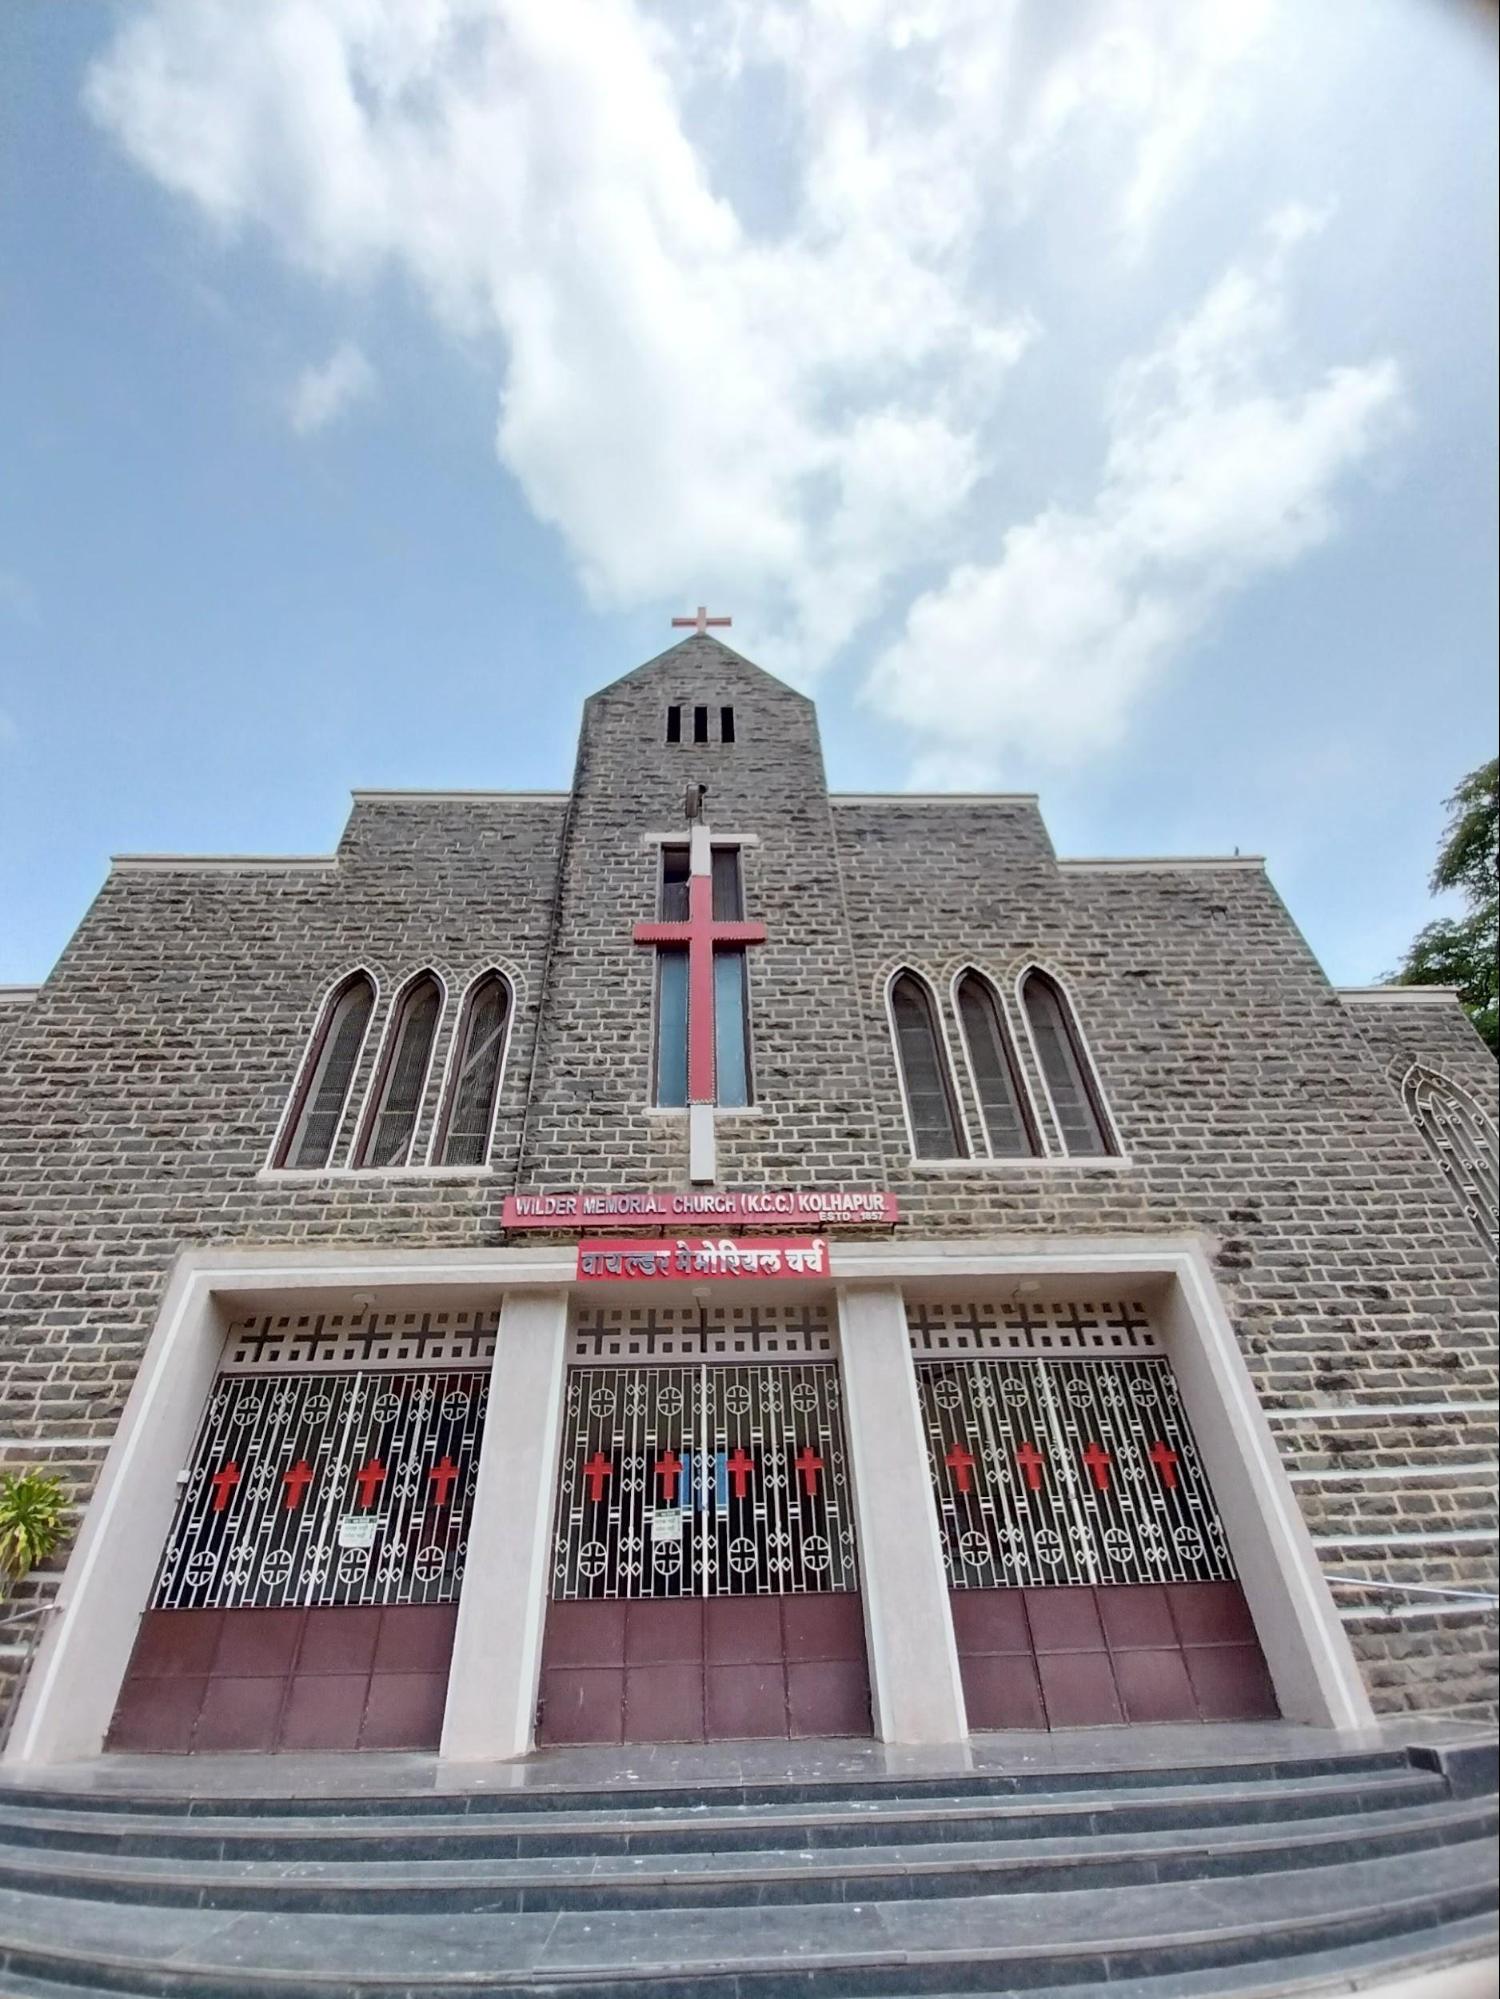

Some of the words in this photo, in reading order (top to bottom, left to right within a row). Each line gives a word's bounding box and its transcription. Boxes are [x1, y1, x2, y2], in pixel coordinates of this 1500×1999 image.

[515, 1197, 577, 1216] WILDER
[583, 1195, 667, 1215] MEMORIAL
[672, 1194, 737, 1214] CHURCH
[740, 1193, 795, 1214] (K.C.C.)
[860, 1211, 884, 1221] 1857
[581, 1250, 671, 1276] वायल्डर
[675, 1240, 782, 1275] मेमोरियल
[785, 1239, 826, 1273] चर्च
